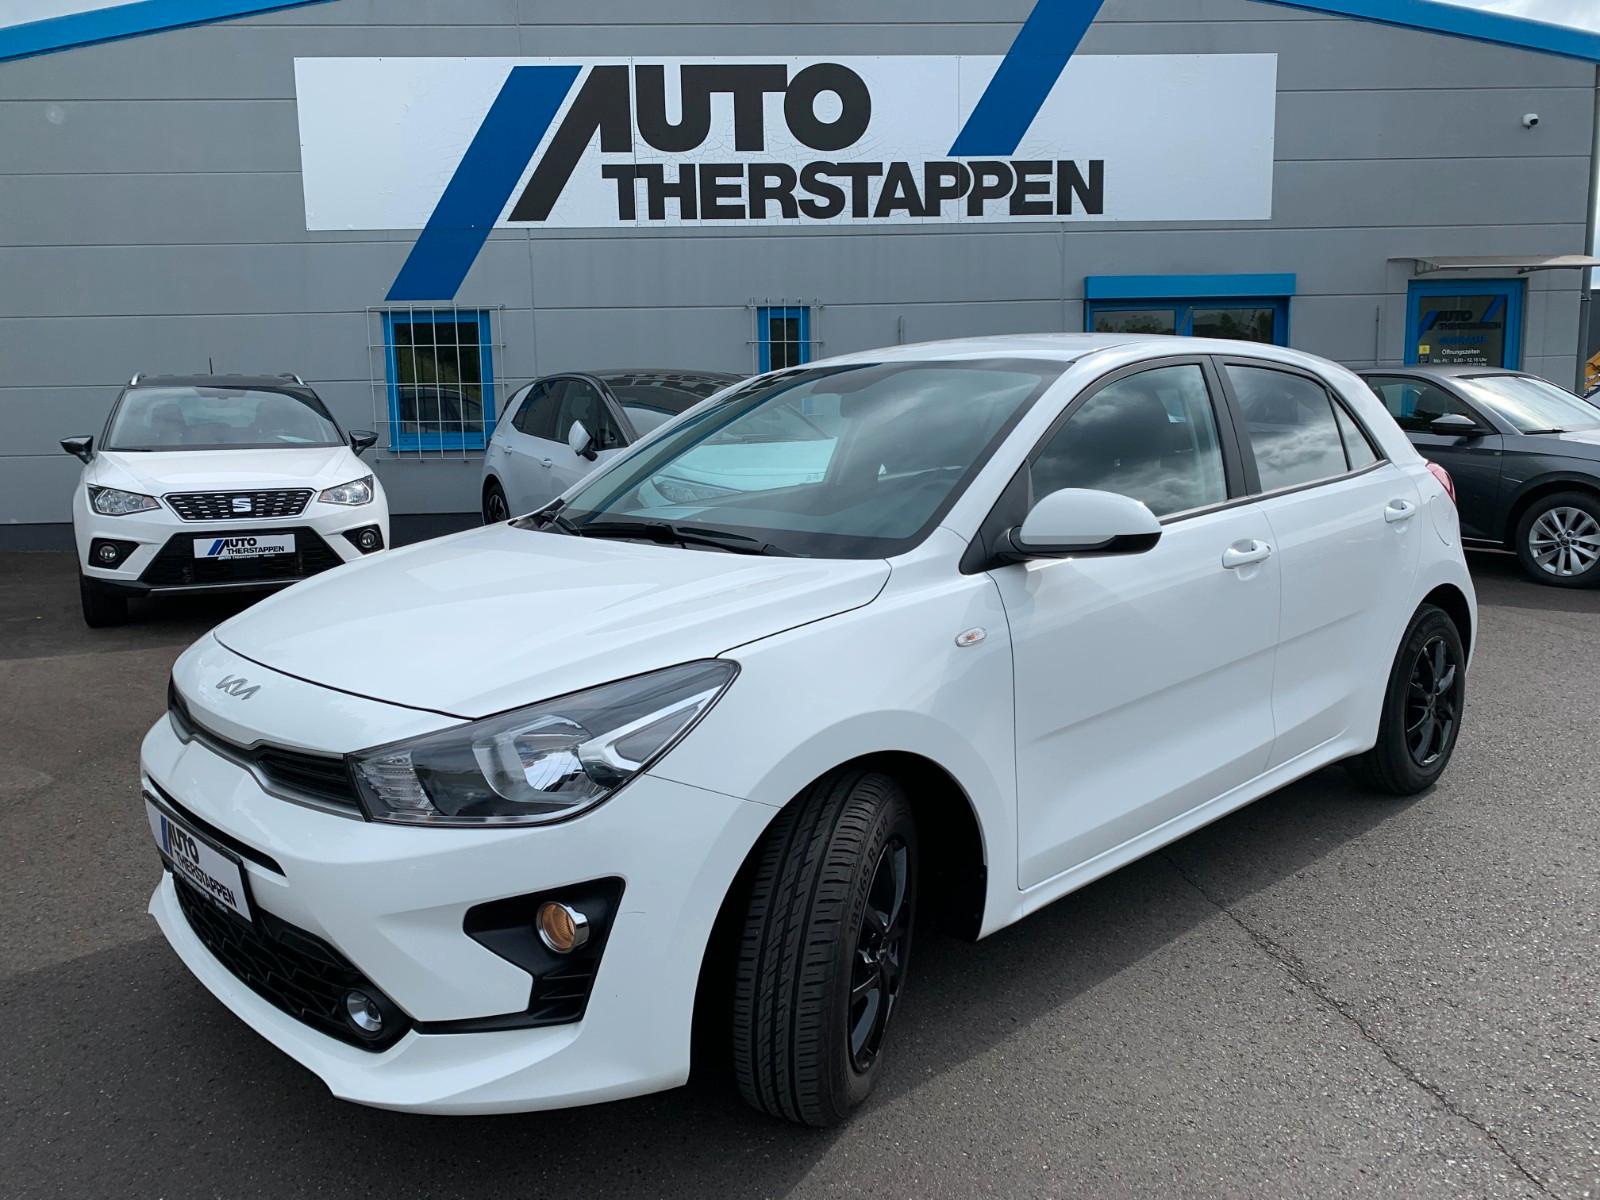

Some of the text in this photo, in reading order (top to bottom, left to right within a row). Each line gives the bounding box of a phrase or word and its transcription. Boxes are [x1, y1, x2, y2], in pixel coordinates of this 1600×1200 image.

[508, 62, 871, 221] AUTO
[603, 159, 1104, 220] THERSTAPPEN
[216, 538, 257, 555] AUTO
[227, 546, 284, 554] THERSTAPPEN
[168, 821, 200, 864] AUTO
[176, 852, 237, 908] THERSTAPPEN
